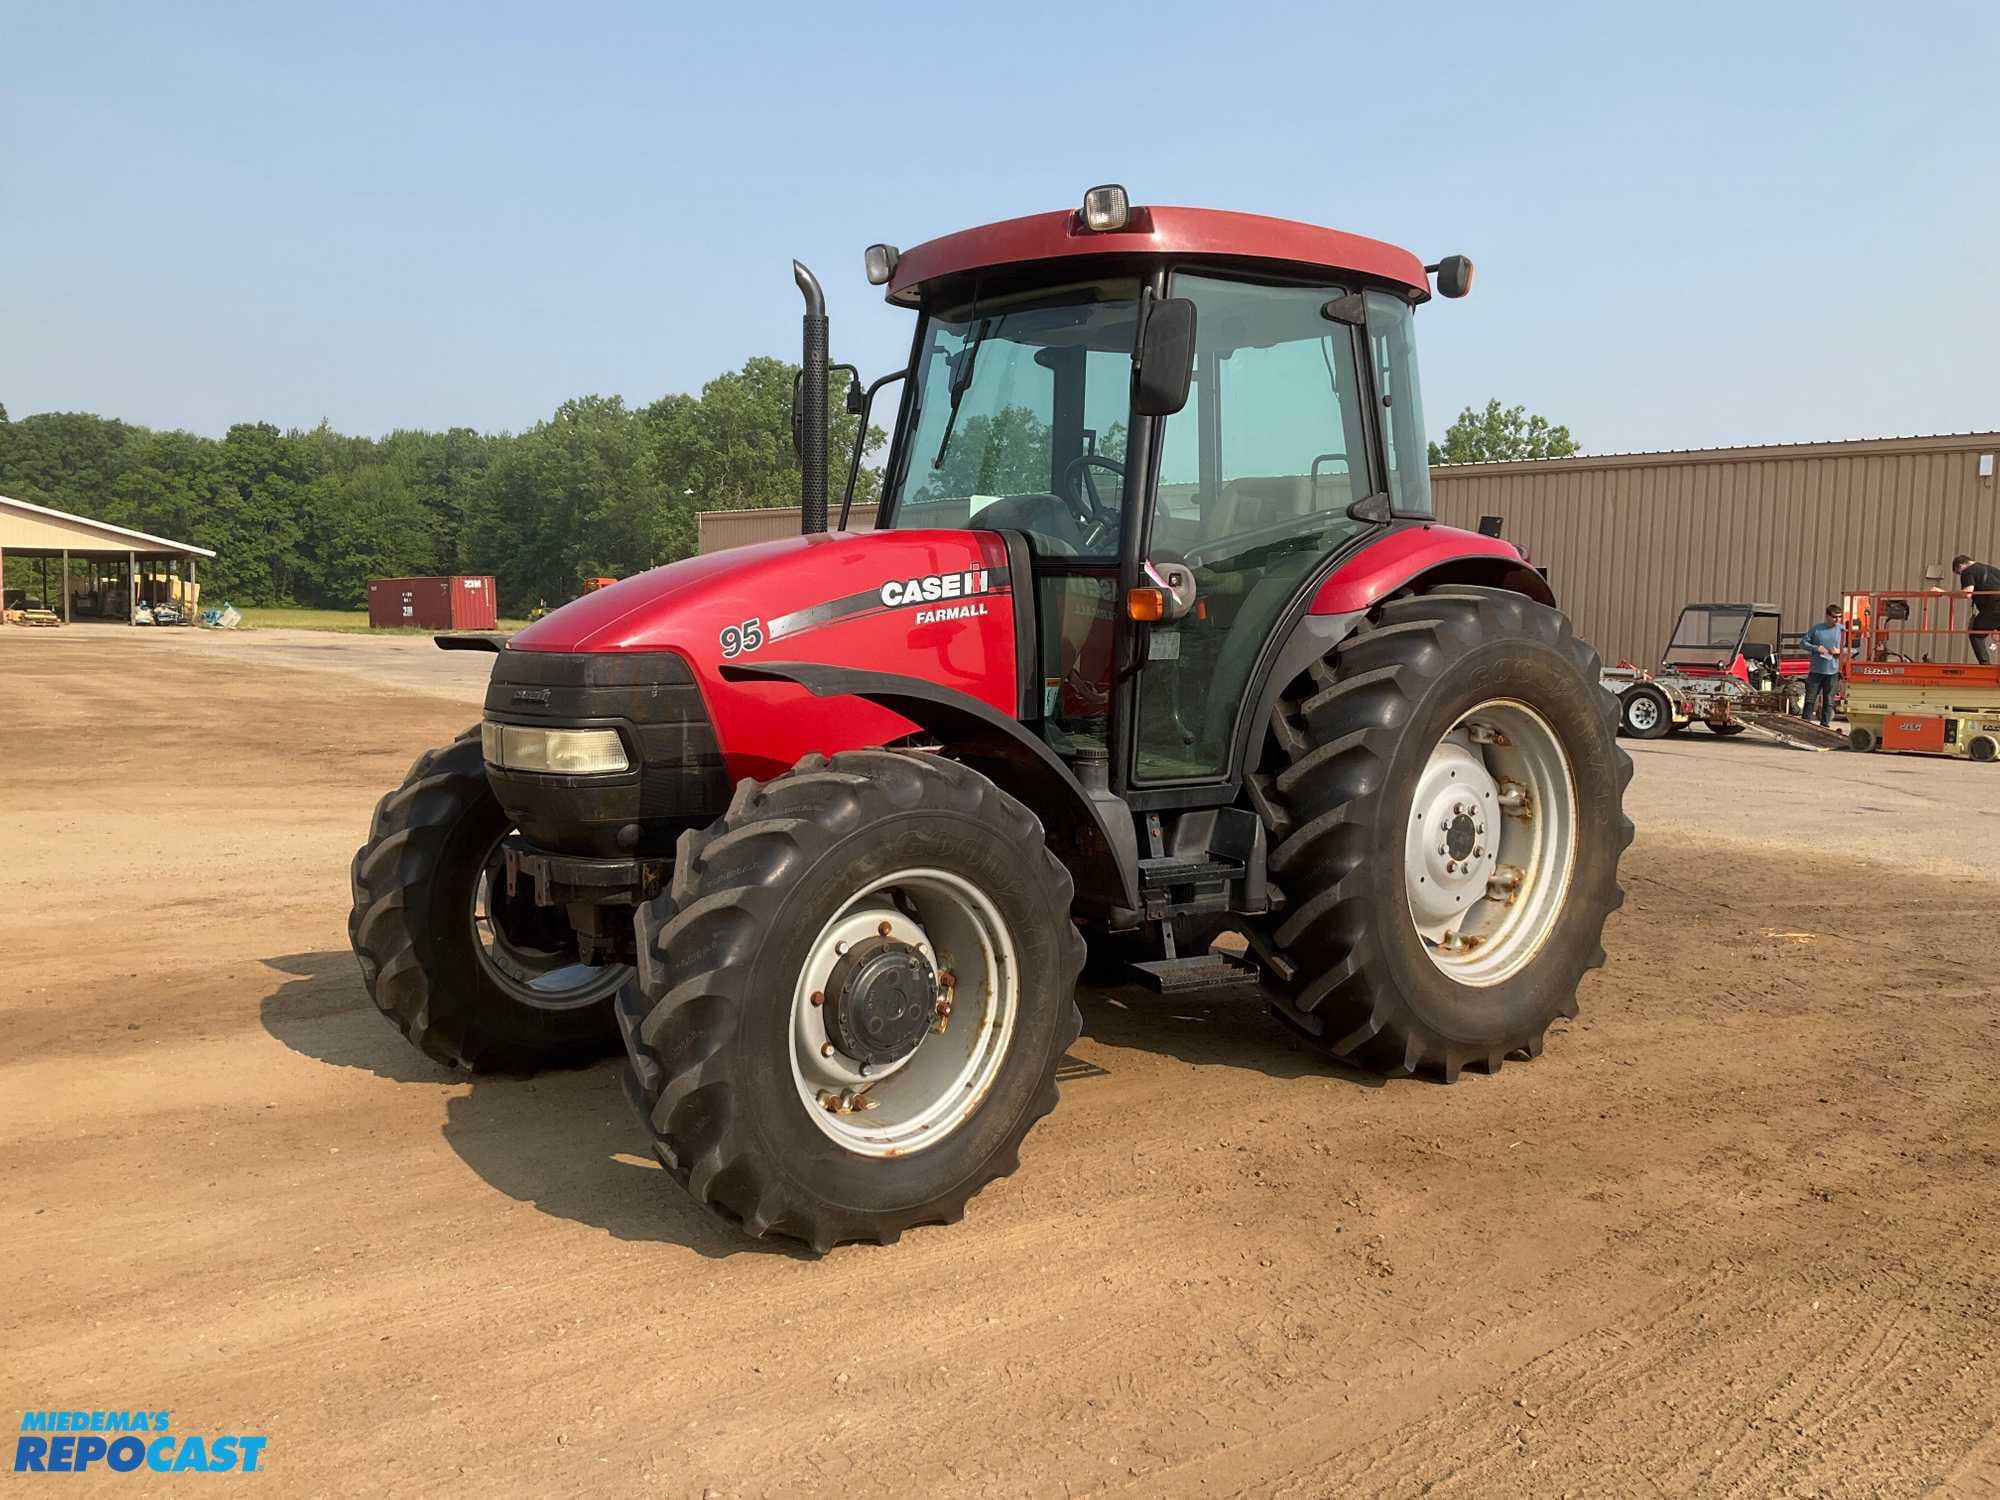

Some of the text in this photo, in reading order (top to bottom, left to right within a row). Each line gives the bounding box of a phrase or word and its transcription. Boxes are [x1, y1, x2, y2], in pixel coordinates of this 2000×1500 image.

[881, 573, 961, 606] CASE
[916, 603, 988, 624] FARMALL
[720, 618, 762, 657] 95
